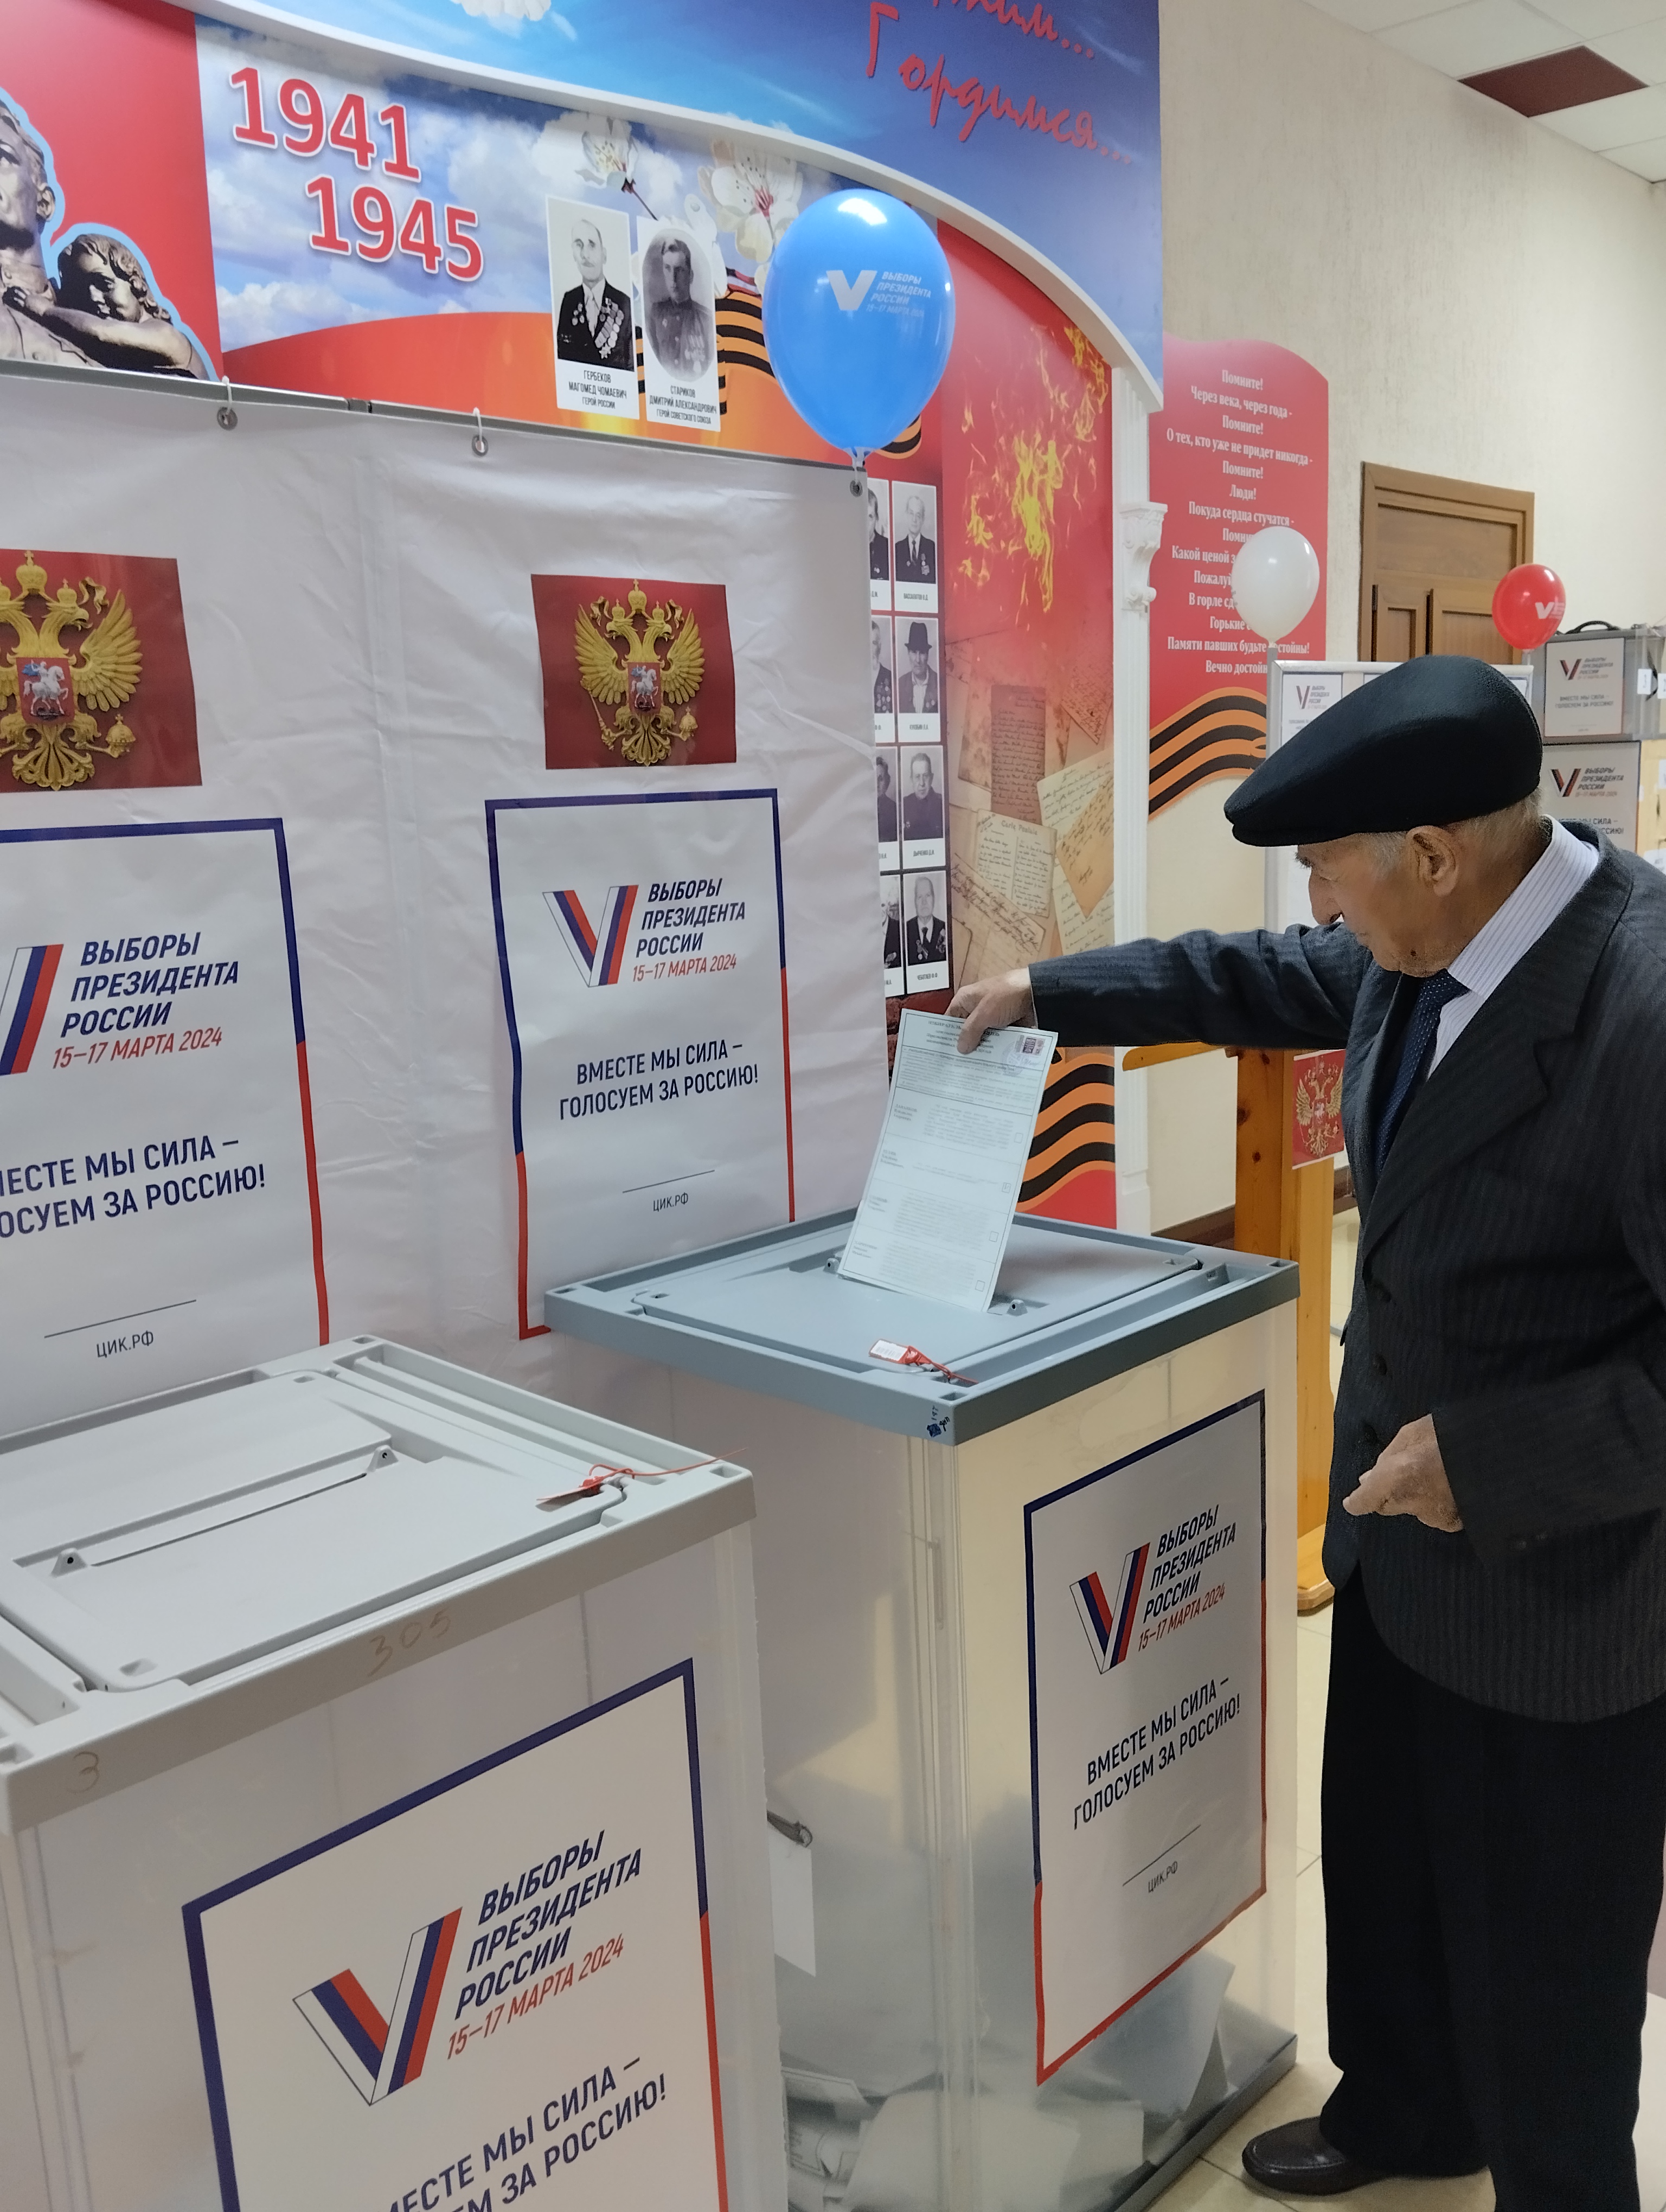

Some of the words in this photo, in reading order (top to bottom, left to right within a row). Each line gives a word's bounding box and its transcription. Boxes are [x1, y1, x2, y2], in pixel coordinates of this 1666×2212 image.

[229, 67, 421, 182] 1941
[305, 176, 484, 282] 1945
[876, 282, 931, 298] ПРЕЗИДЕНТА
[882, 272, 921, 285] ВЫБОРЫ
[870, 293, 909, 305] РОССИИ
[569, 381, 596, 395] МАГОМЕД
[598, 386, 627, 400] ЧОМАЕВИЧ
[584, 370, 611, 383] ГЕРБЕКОВ
[670, 385, 695, 398] СТАРИКОВ
[1222, 370, 1263, 390] Помните!
[582, 396, 597, 406] ГЕРОЙ
[598, 399, 616, 409] РОССИИ
[649, 395, 674, 408] ДМИТРИЙ
[675, 399, 717, 414] АЛЕКСАНДРОВИЧ
[1191, 385, 1217, 404] Через
[1220, 394, 1241, 410] века,
[1244, 399, 1267, 415] через
[1269, 407, 1287, 419] года
[1222, 415, 1263, 434] Помните!
[1167, 428, 1174, 441] О
[1176, 432, 1193, 447] тех,
[1195, 436, 1210, 448] кто
[1212, 439, 1229, 452] уже
[1232, 443, 1241, 453] не
[1244, 445, 1274, 459] придет
[1276, 450, 1308, 466] никогда
[1223, 460, 1263, 479] Помните!
[1229, 484, 1256, 501] Люди!
[1189, 501, 1220, 519] Покуда
[1222, 509, 1252, 523] сердца
[1253, 513, 1290, 527] стучатся
[1172, 545, 1200, 561] Какой
[1202, 551, 1229, 564] ценой
[1189, 593, 1195, 605] В
[1197, 596, 1222, 610] горле
[1210, 616, 1245, 633] Горькие
[1168, 636, 1202, 650] Памяти
[1204, 641, 1238, 652] павших
[1239, 639, 1267, 655] будьте
[1276, 641, 1310, 654] стойны!
[1206, 660, 1232, 674] Вечно
[1234, 661, 1268, 676] достойн
[648, 878, 722, 903] ВЫБОРЫ
[642, 902, 746, 930] ПРЕЗИДЕНТА
[81, 932, 201, 967] ВЫБОРЫ
[636, 933, 703, 958] РОССИИ
[71, 961, 239, 1001] ПРЕЗИДЕНТА
[633, 962, 666, 982] 15–17
[668, 956, 707, 979] МАРТА
[709, 953, 736, 973] 2024
[61, 1002, 172, 1038] РОССИИ
[53, 1042, 107, 1070] 15–17
[111, 1033, 174, 1061] МАРТА
[178, 1026, 223, 1052] 2024
[577, 1053, 645, 1085] ВМЕСТЕ
[651, 1047, 680, 1072] МЫ
[685, 1039, 728, 1064] СИЛА
[560, 1083, 653, 1120] ГОЛОСУЕМ
[658, 1079, 680, 1102] ЗА
[684, 1064, 759, 1096] РОССИЮ!
[0, 1159, 76, 1197] ЕСТЕ
[86, 1148, 134, 1181] МЫ
[144, 1135, 216, 1172] СИЛА
[0, 1195, 95, 1238] ОСУЕМ
[104, 1191, 138, 1218] ЗА
[147, 1163, 266, 1211] РОССИЮ!
[653, 1192, 689, 1212] ЦИК.РФ
[97, 1330, 154, 1359] ЦИК.РФ
[1157, 1504, 1219, 1558] ВЫБОРЫ
[1150, 1522, 1236, 1591] ПРЕЗИДЕНТА
[1144, 1571, 1201, 1624] РОССИИ
[1138, 1619, 1168, 1652] 15–17
[1169, 1601, 1201, 1635] МАРТА
[1203, 1583, 1226, 1613] 2024
[1087, 1725, 1146, 1785] ВМЕСТЕ
[1151, 1709, 1176, 1741] МЫ
[1181, 1683, 1217, 1721] СИЛА
[67, 1751, 100, 1793] 3
[1074, 1757, 1154, 1830] ГОЛОСУЕМ
[1158, 1744, 1176, 1771] ЗА
[1180, 1693, 1241, 1757] РОССИЮ!
[478, 1830, 605, 1926] ВЫБОРЫ
[1148, 1860, 1178, 1894] ЦИК.РФ
[466, 1848, 641, 1973] ПРЕЗИДЕНТА
[454, 1926, 572, 2020] РОССИИ
[447, 2007, 505, 2060] 15–17
[508, 1963, 574, 2024] МАРТА
[579, 1933, 624, 1979] 2024
[390, 2154, 474, 2212] ЕСТЕ
[483, 2115, 534, 2173] МЫ
[543, 2065, 616, 2132] СИЛА
[501, 2163, 536, 2204] ЗА
[544, 2073, 667, 2178] РОССИЮ!
